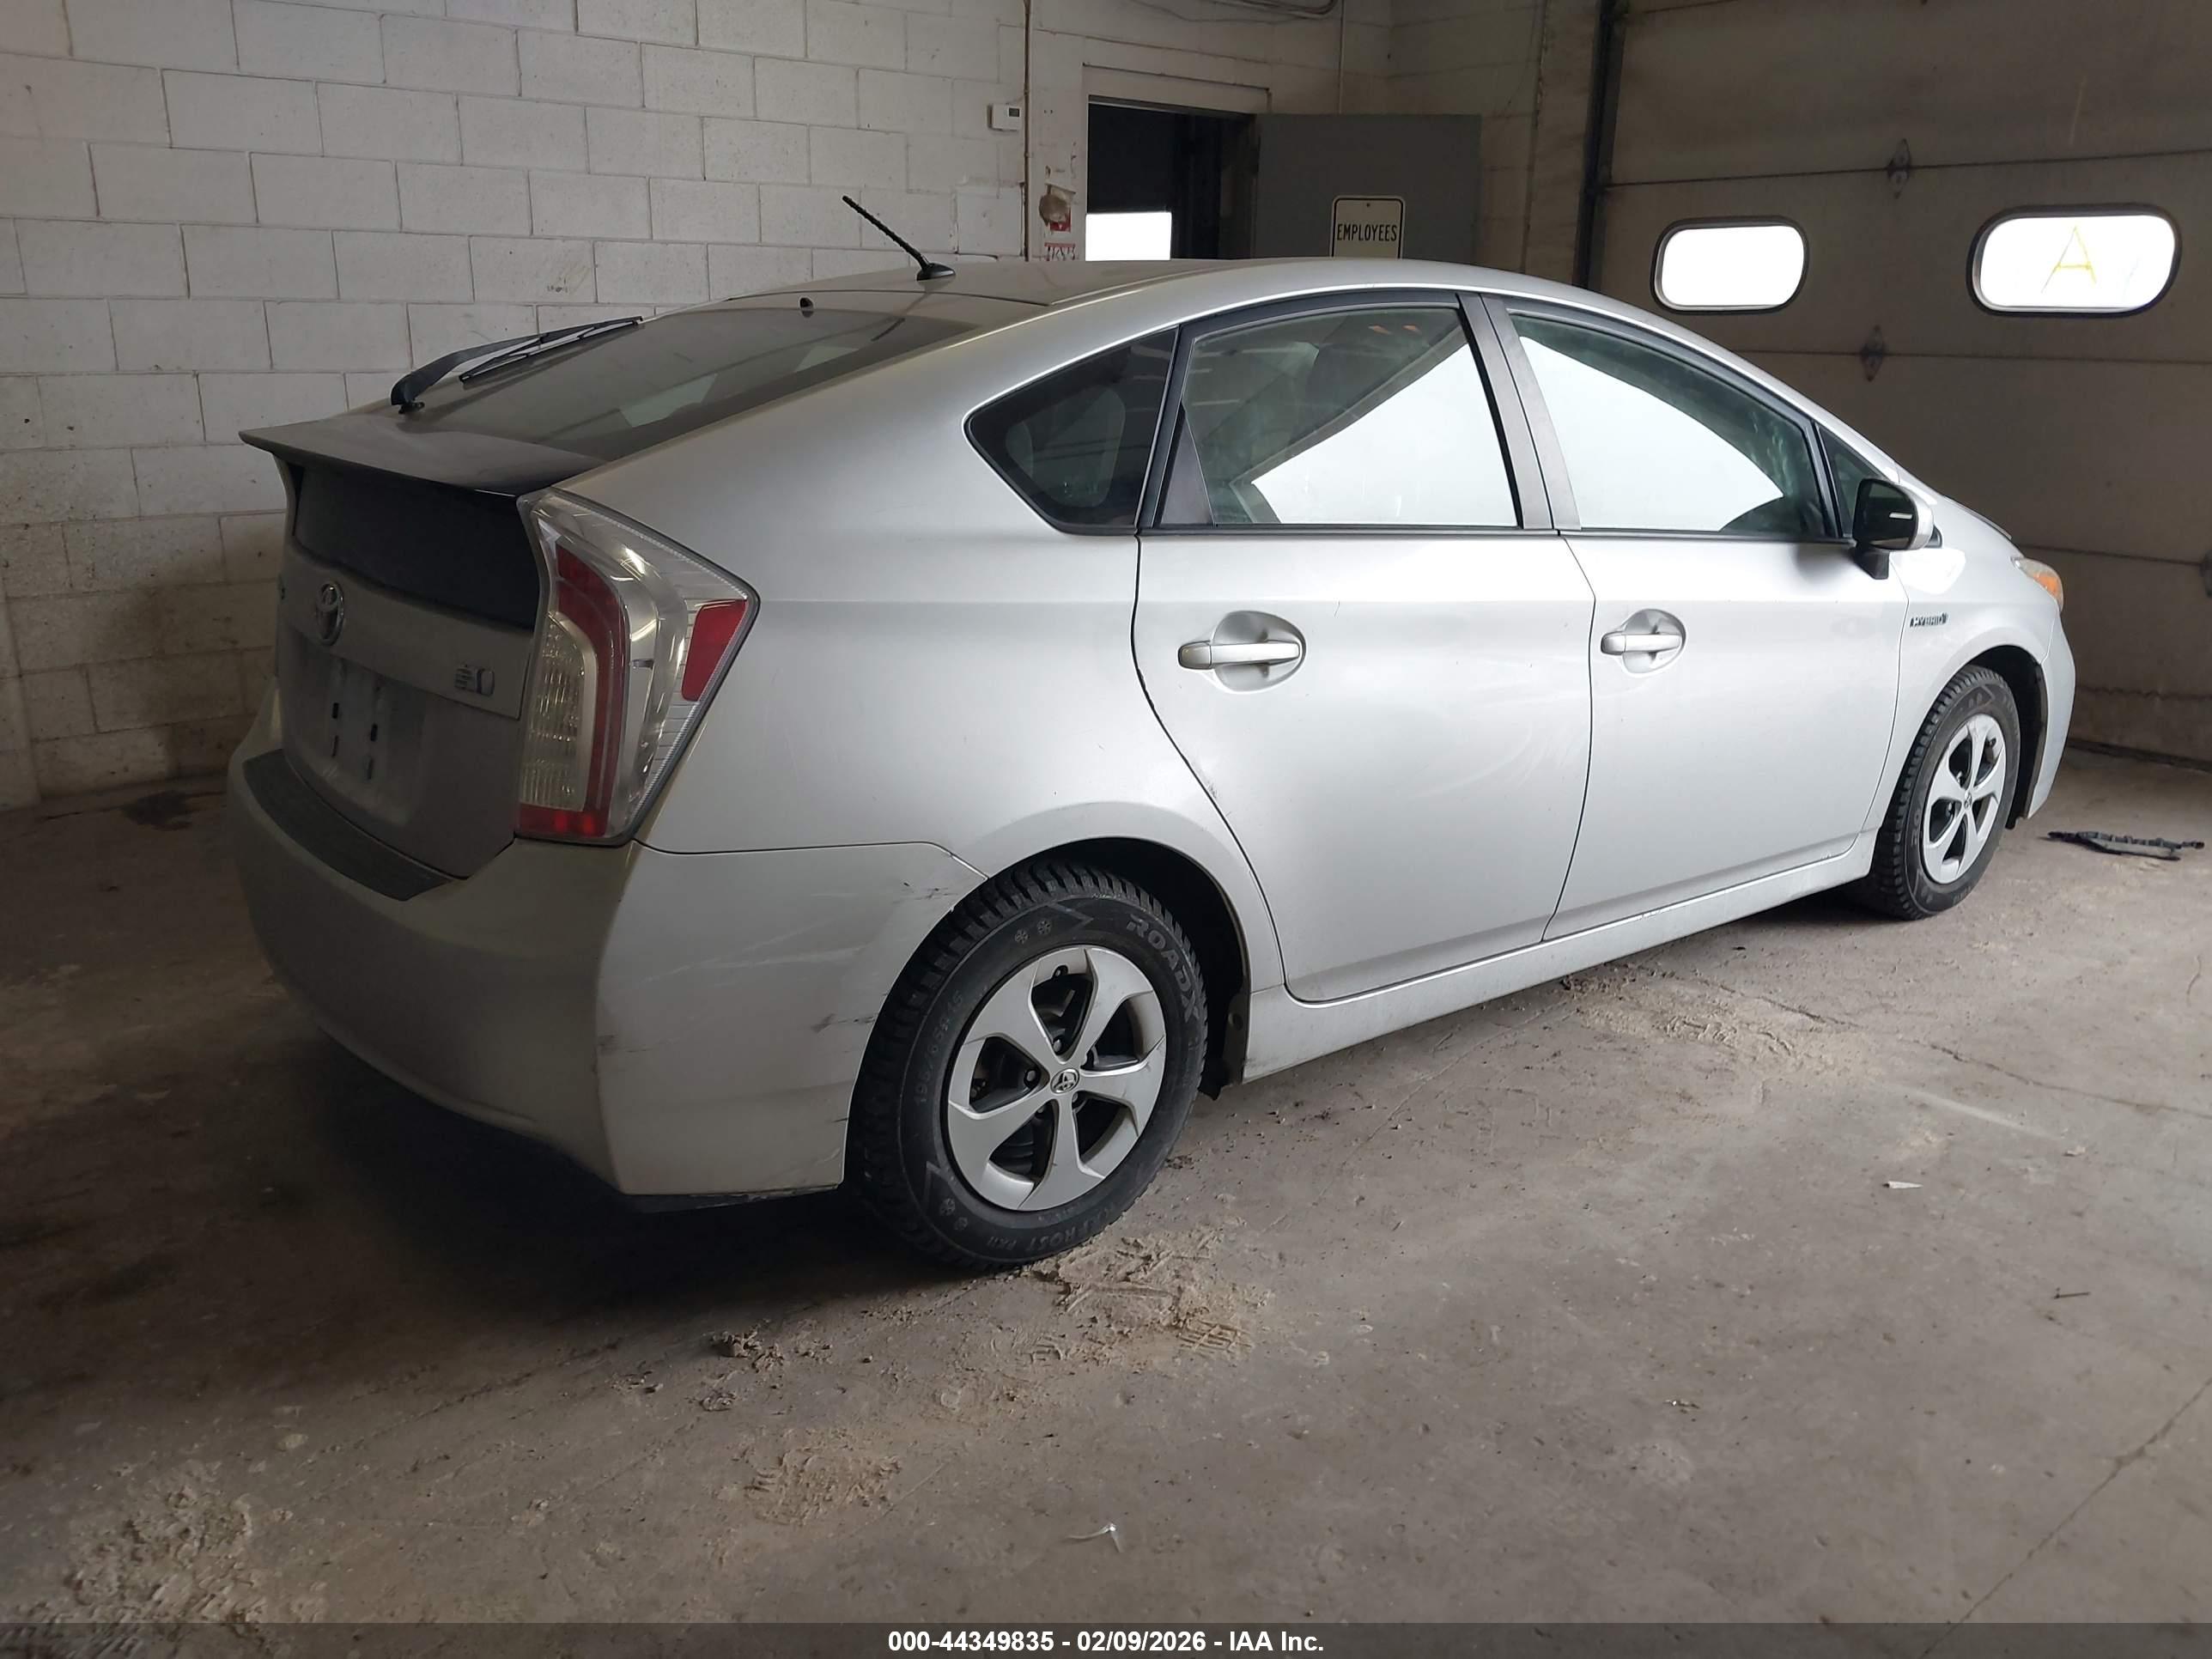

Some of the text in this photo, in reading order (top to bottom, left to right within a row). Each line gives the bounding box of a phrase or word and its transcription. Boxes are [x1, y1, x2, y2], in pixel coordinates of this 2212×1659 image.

[1336, 223, 1398, 242] EMPLOYEES
[2040, 225, 2097, 294] A
[1127, 914, 1200, 1023] ROADX
